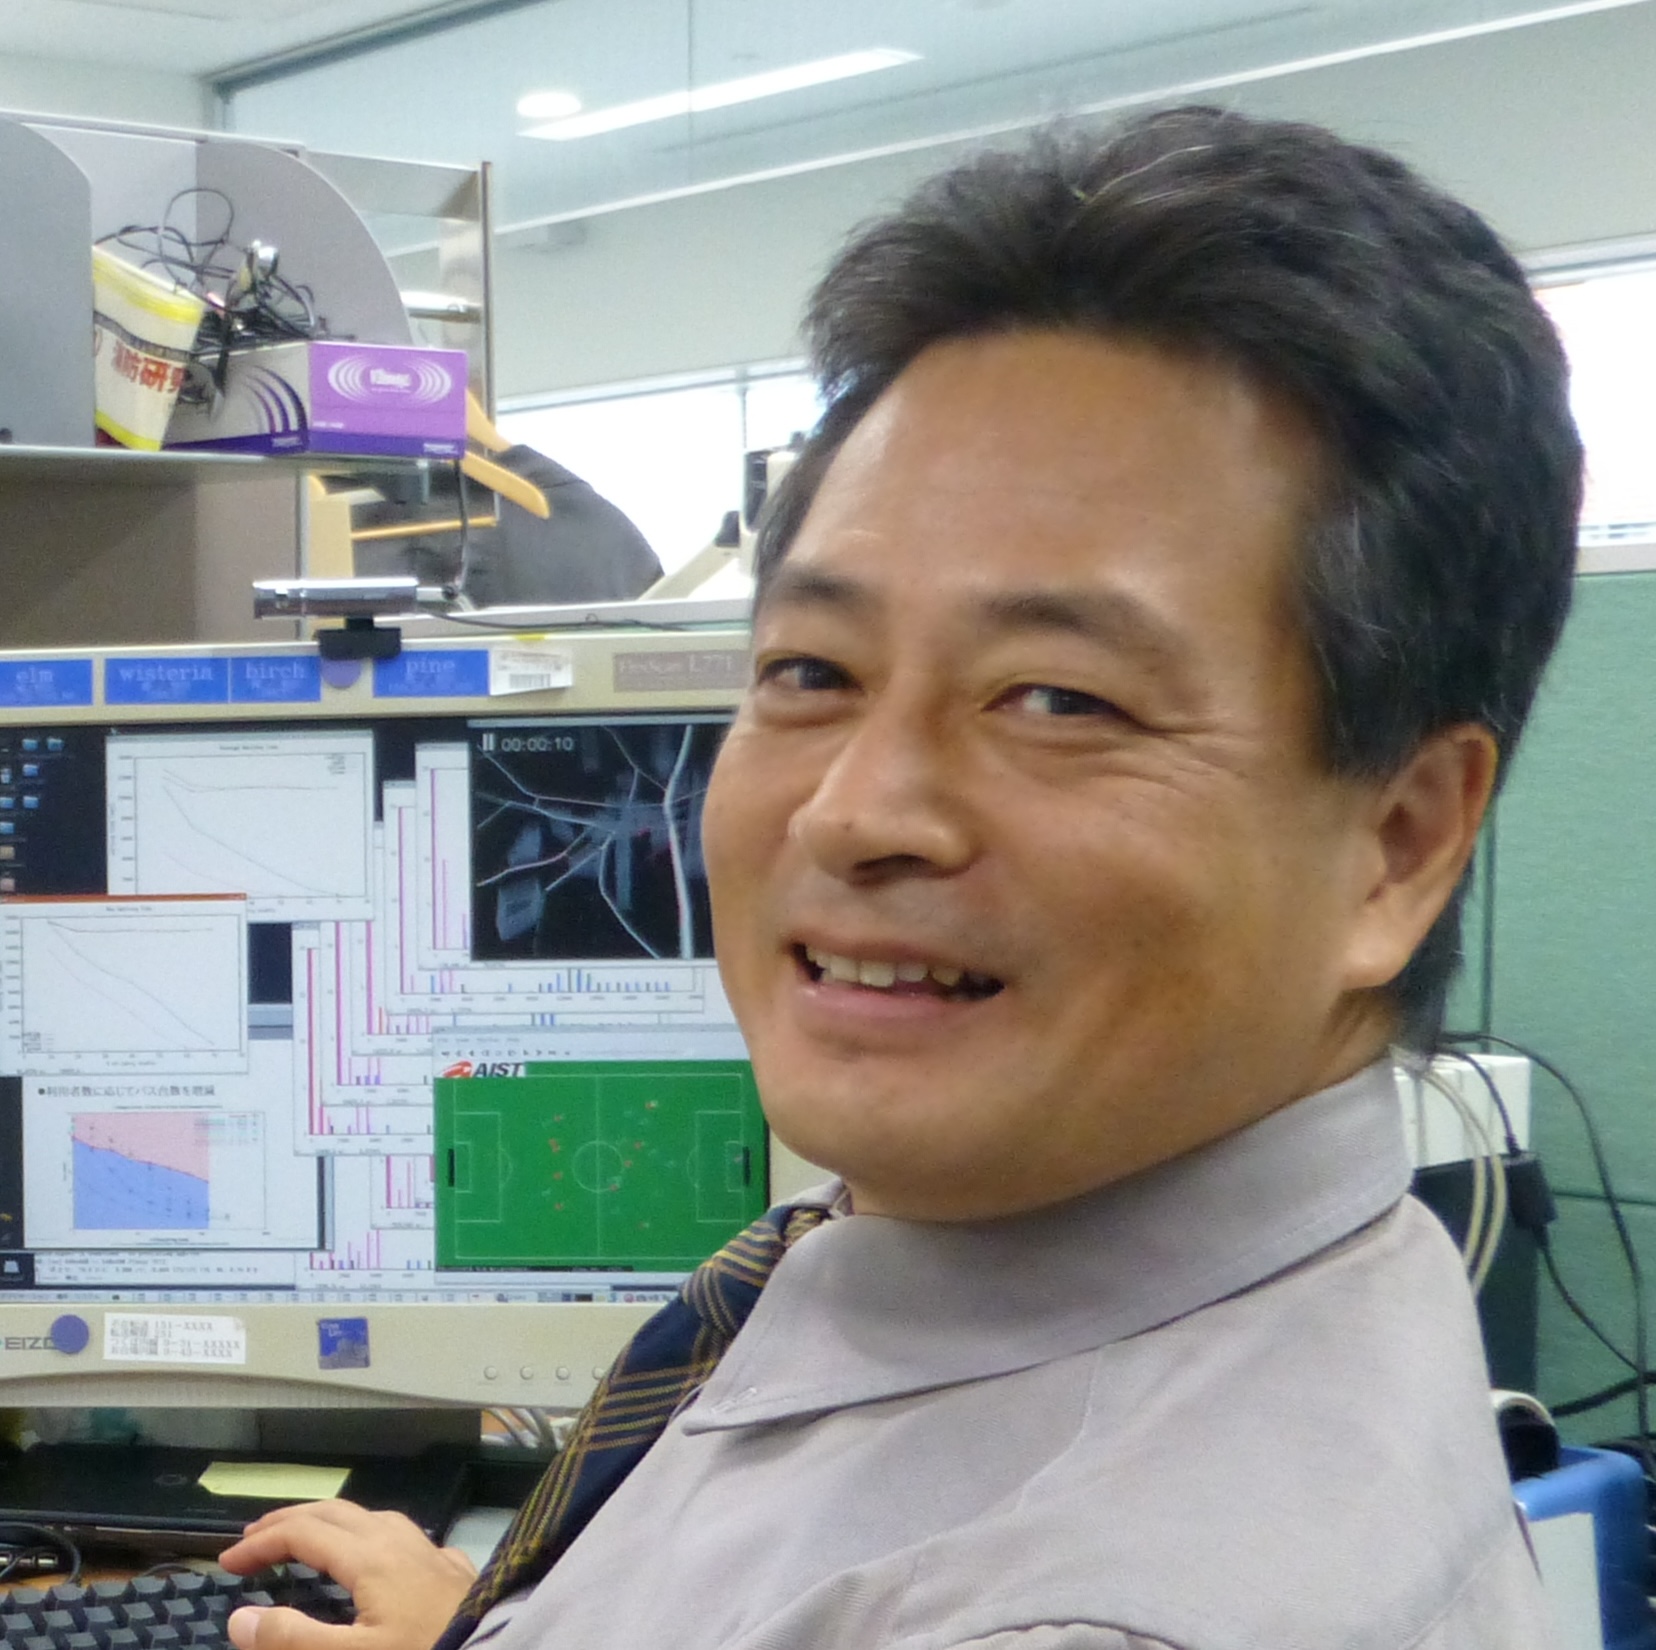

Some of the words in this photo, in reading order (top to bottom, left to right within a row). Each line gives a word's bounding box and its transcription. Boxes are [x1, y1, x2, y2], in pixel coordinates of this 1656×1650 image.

[118, 662, 214, 682] wisteria
[245, 661, 306, 681] birch
[405, 656, 456, 675] pine
[501, 736, 573, 752] 00:00:10
[473, 1062, 523, 1077] AIST
